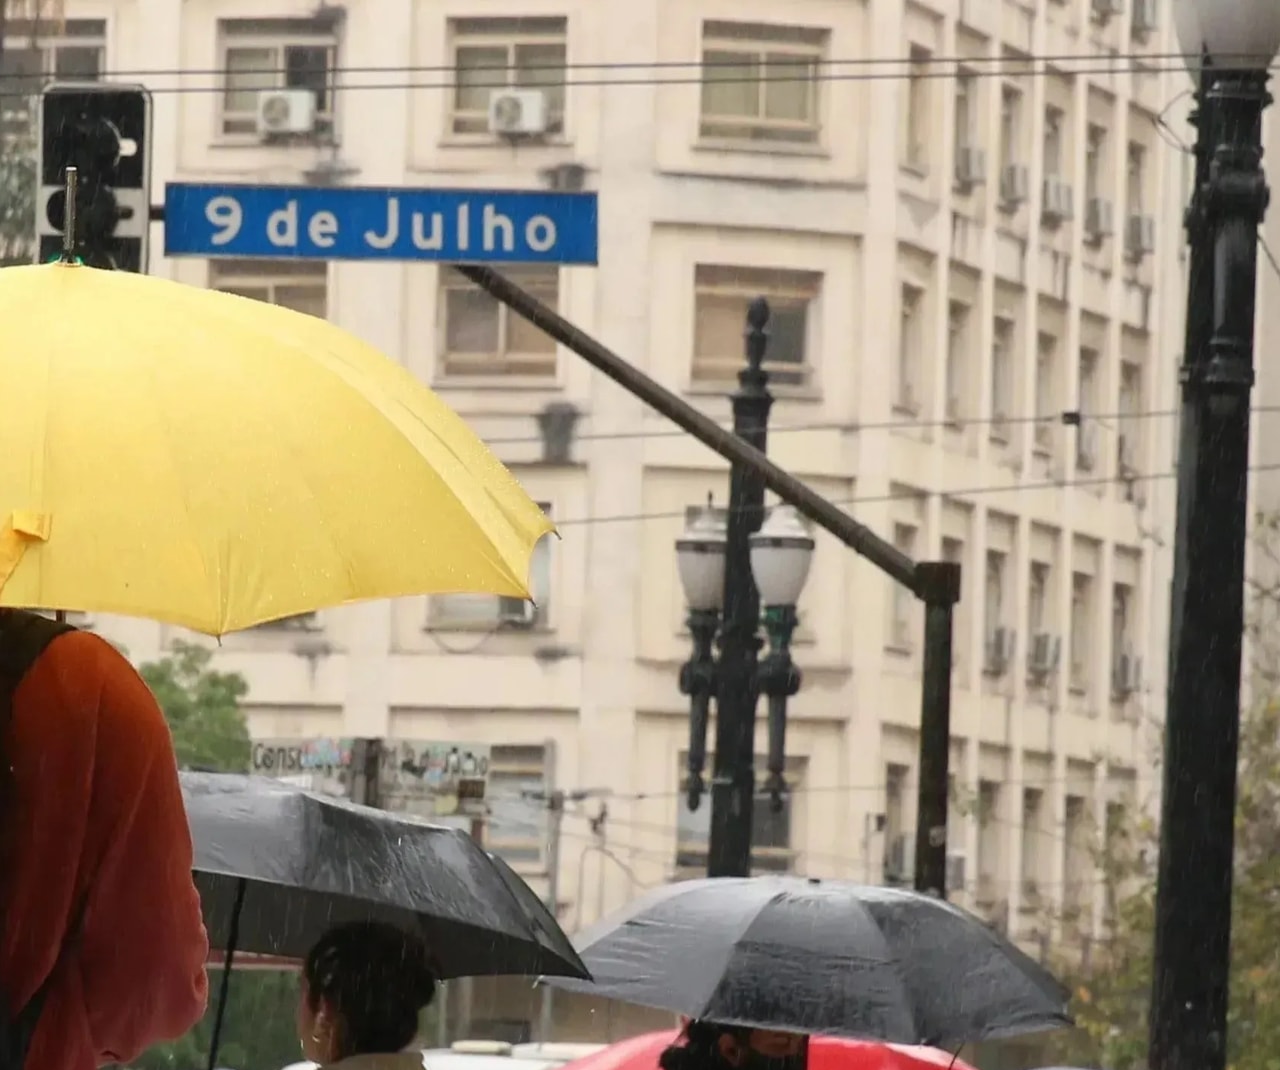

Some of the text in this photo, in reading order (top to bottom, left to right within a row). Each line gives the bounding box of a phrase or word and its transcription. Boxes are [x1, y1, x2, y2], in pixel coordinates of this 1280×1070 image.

[205, 195, 557, 252] 9 de Julho
